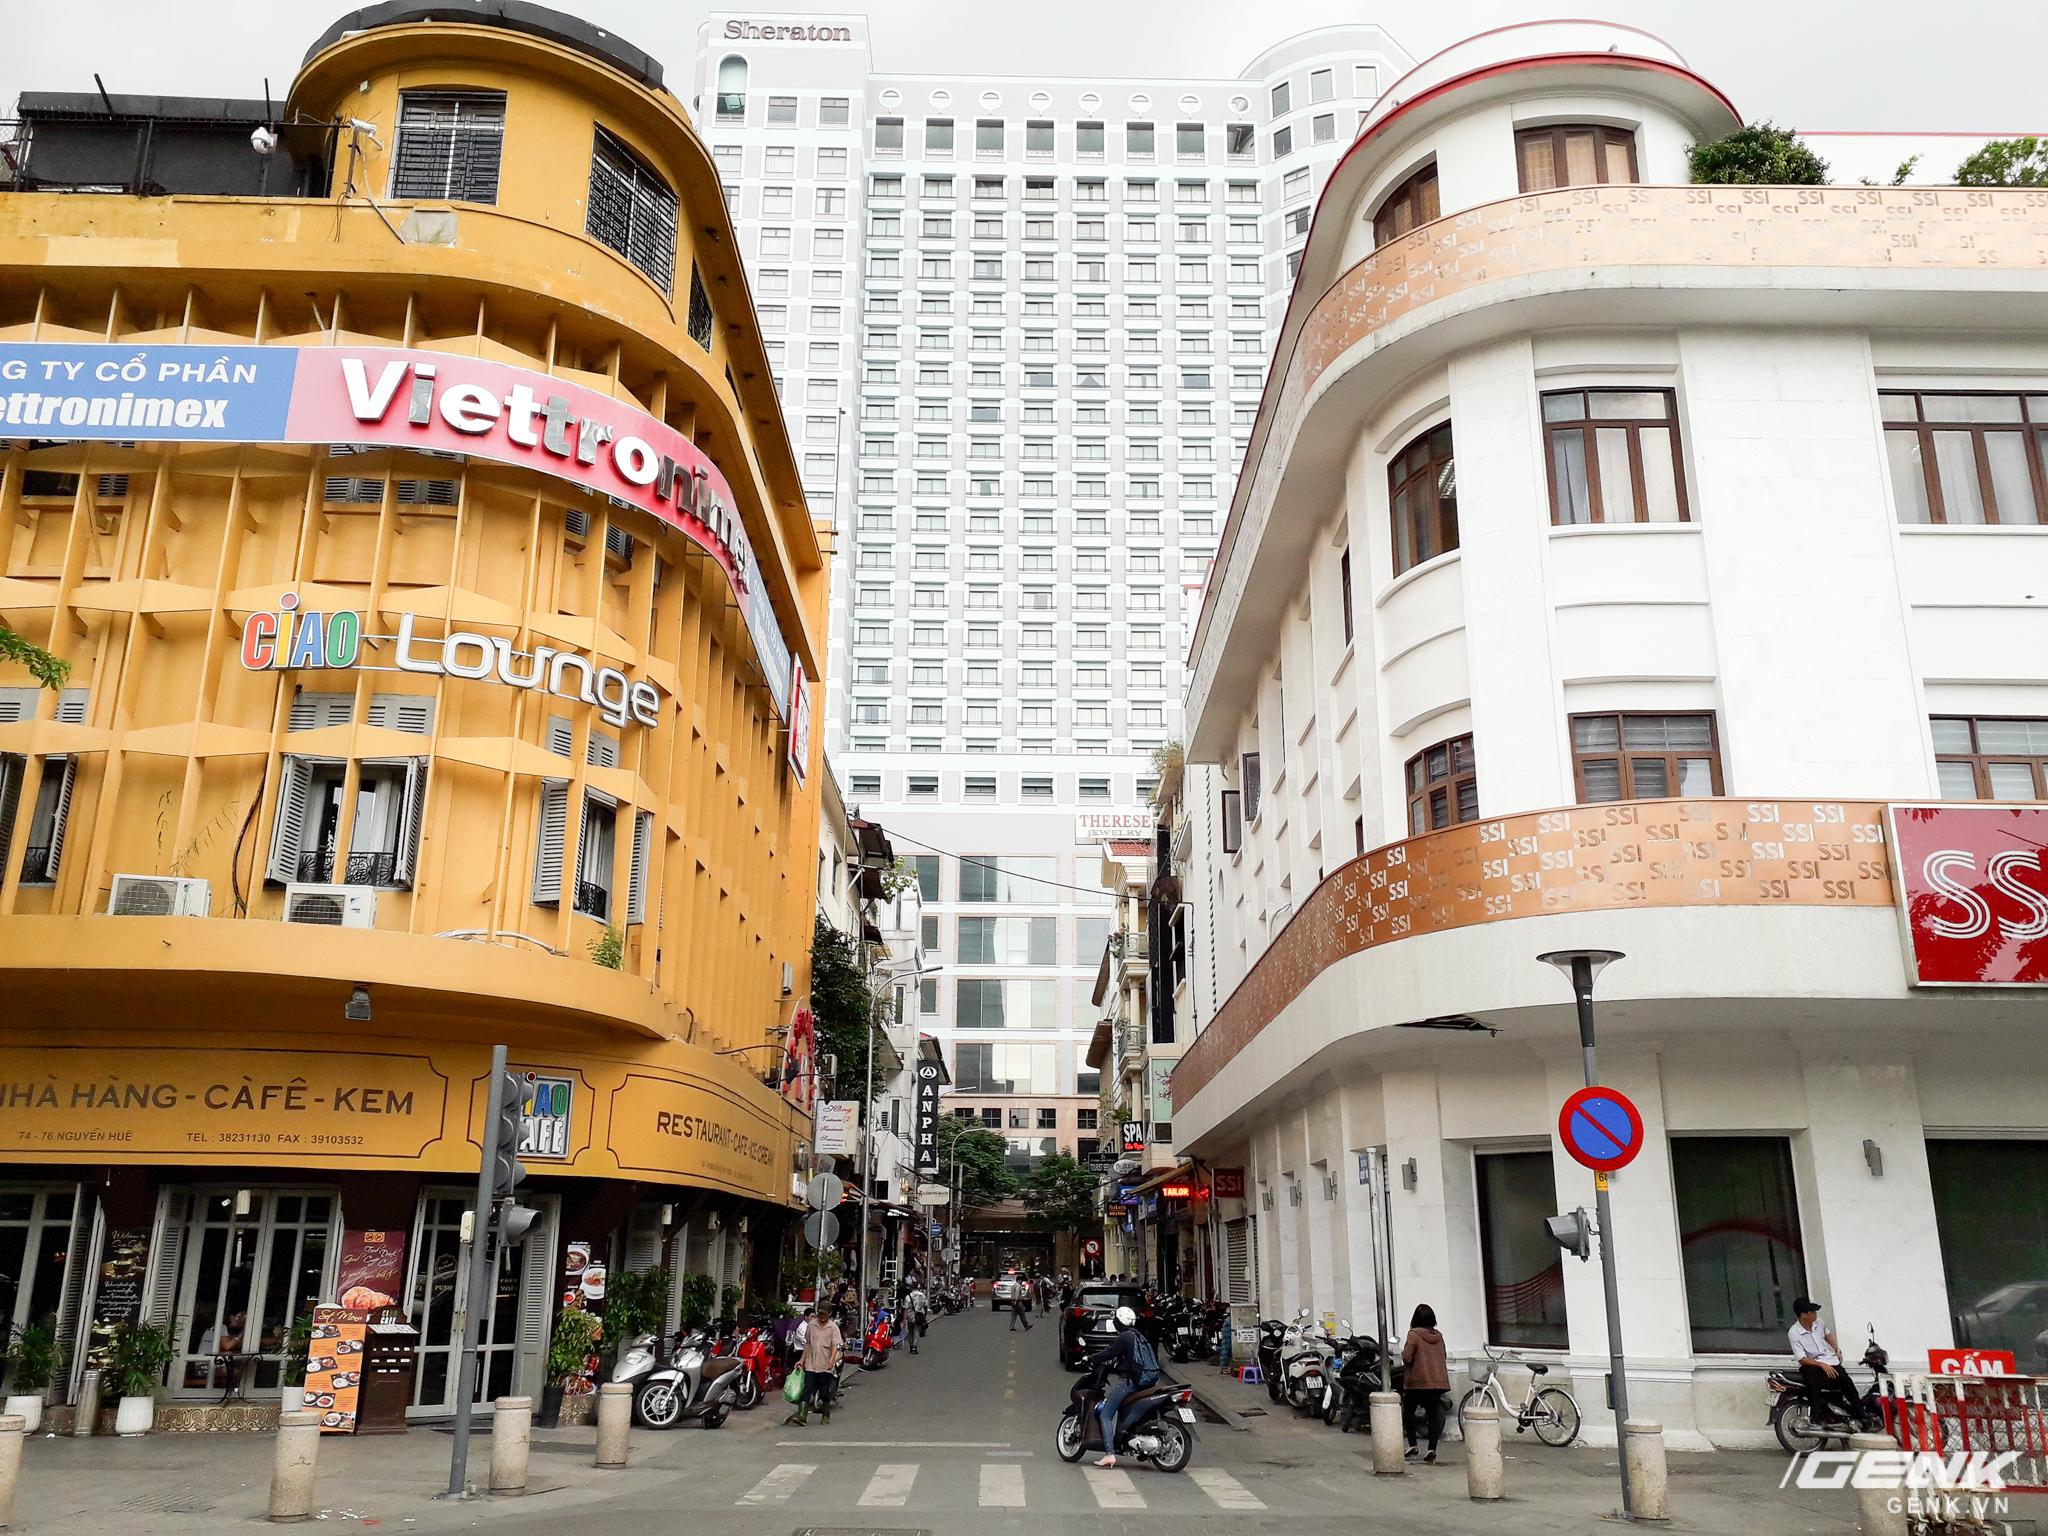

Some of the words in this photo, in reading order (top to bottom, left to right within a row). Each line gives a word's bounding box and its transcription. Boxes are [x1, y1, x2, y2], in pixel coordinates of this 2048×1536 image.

[724, 20, 851, 41] Sheraton
[1687, 190, 1712, 204] SSI
[1743, 190, 1769, 205] SSI
[1797, 191, 1824, 205] SSI
[1856, 191, 1883, 205] SSI
[1912, 192, 1939, 207] SSI
[1967, 193, 1994, 207] SSI
[0, 360, 27, 381] G
[40, 360, 87, 382] TY
[95, 352, 147, 382] CỔ
[157, 355, 258, 384] PHẦN
[394, 611, 661, 729] Lounge
[1079, 814, 1151, 827] THERESE
[1538, 813, 1571, 833] SSI
[1606, 807, 1639, 826] SSI
[1747, 804, 1780, 823] SSI
[1813, 805, 1845, 823] SSI
[1479, 823, 1506, 844] SSI
[1574, 828, 1606, 848] SSI
[1645, 824, 1680, 841] SSI
[1782, 824, 1815, 842] SSI
[1852, 824, 1884, 843] SSI
[1508, 836, 1538, 857] SSI
[1610, 845, 1642, 864] SSI
[1752, 842, 1785, 860] SSI
[1818, 844, 1851, 861] SSI
[1387, 846, 1406, 867] SSI
[1540, 850, 1574, 871] SSI
[1483, 859, 1508, 880] SSI
[1720, 860, 1751, 879] SSI
[1788, 861, 1821, 879] SSI
[1370, 870, 1387, 890] SSI
[1511, 872, 1541, 893] SSI
[1760, 880, 1790, 898] SSI
[1388, 880, 1409, 901] SSI
[1822, 881, 1856, 899] SSI
[1485, 895, 1512, 916] SSI
[1391, 915, 1411, 935] SSI
[0, 1073, 60, 1108] HÀ
[70, 1074, 178, 1109] HÀNG
[204, 1075, 308, 1110] CÀFÊ
[333, 1087, 414, 1115] KEM
[656, 1110, 731, 1147] RESTAURANT
[919, 1084, 934, 1162] ANPHA
[41, 1132, 53, 1140] 76
[187, 1133, 207, 1142] TEL
[219, 1133, 271, 1143] 38231130
[277, 1134, 300, 1143] FAX
[311, 1135, 364, 1145] 39103532
[519, 1117, 565, 1153] AFÉ
[1123, 1123, 1142, 1143] SPA
[1162, 1187, 1190, 1197] TAILOR
[1216, 1175, 1242, 1192] SSI
